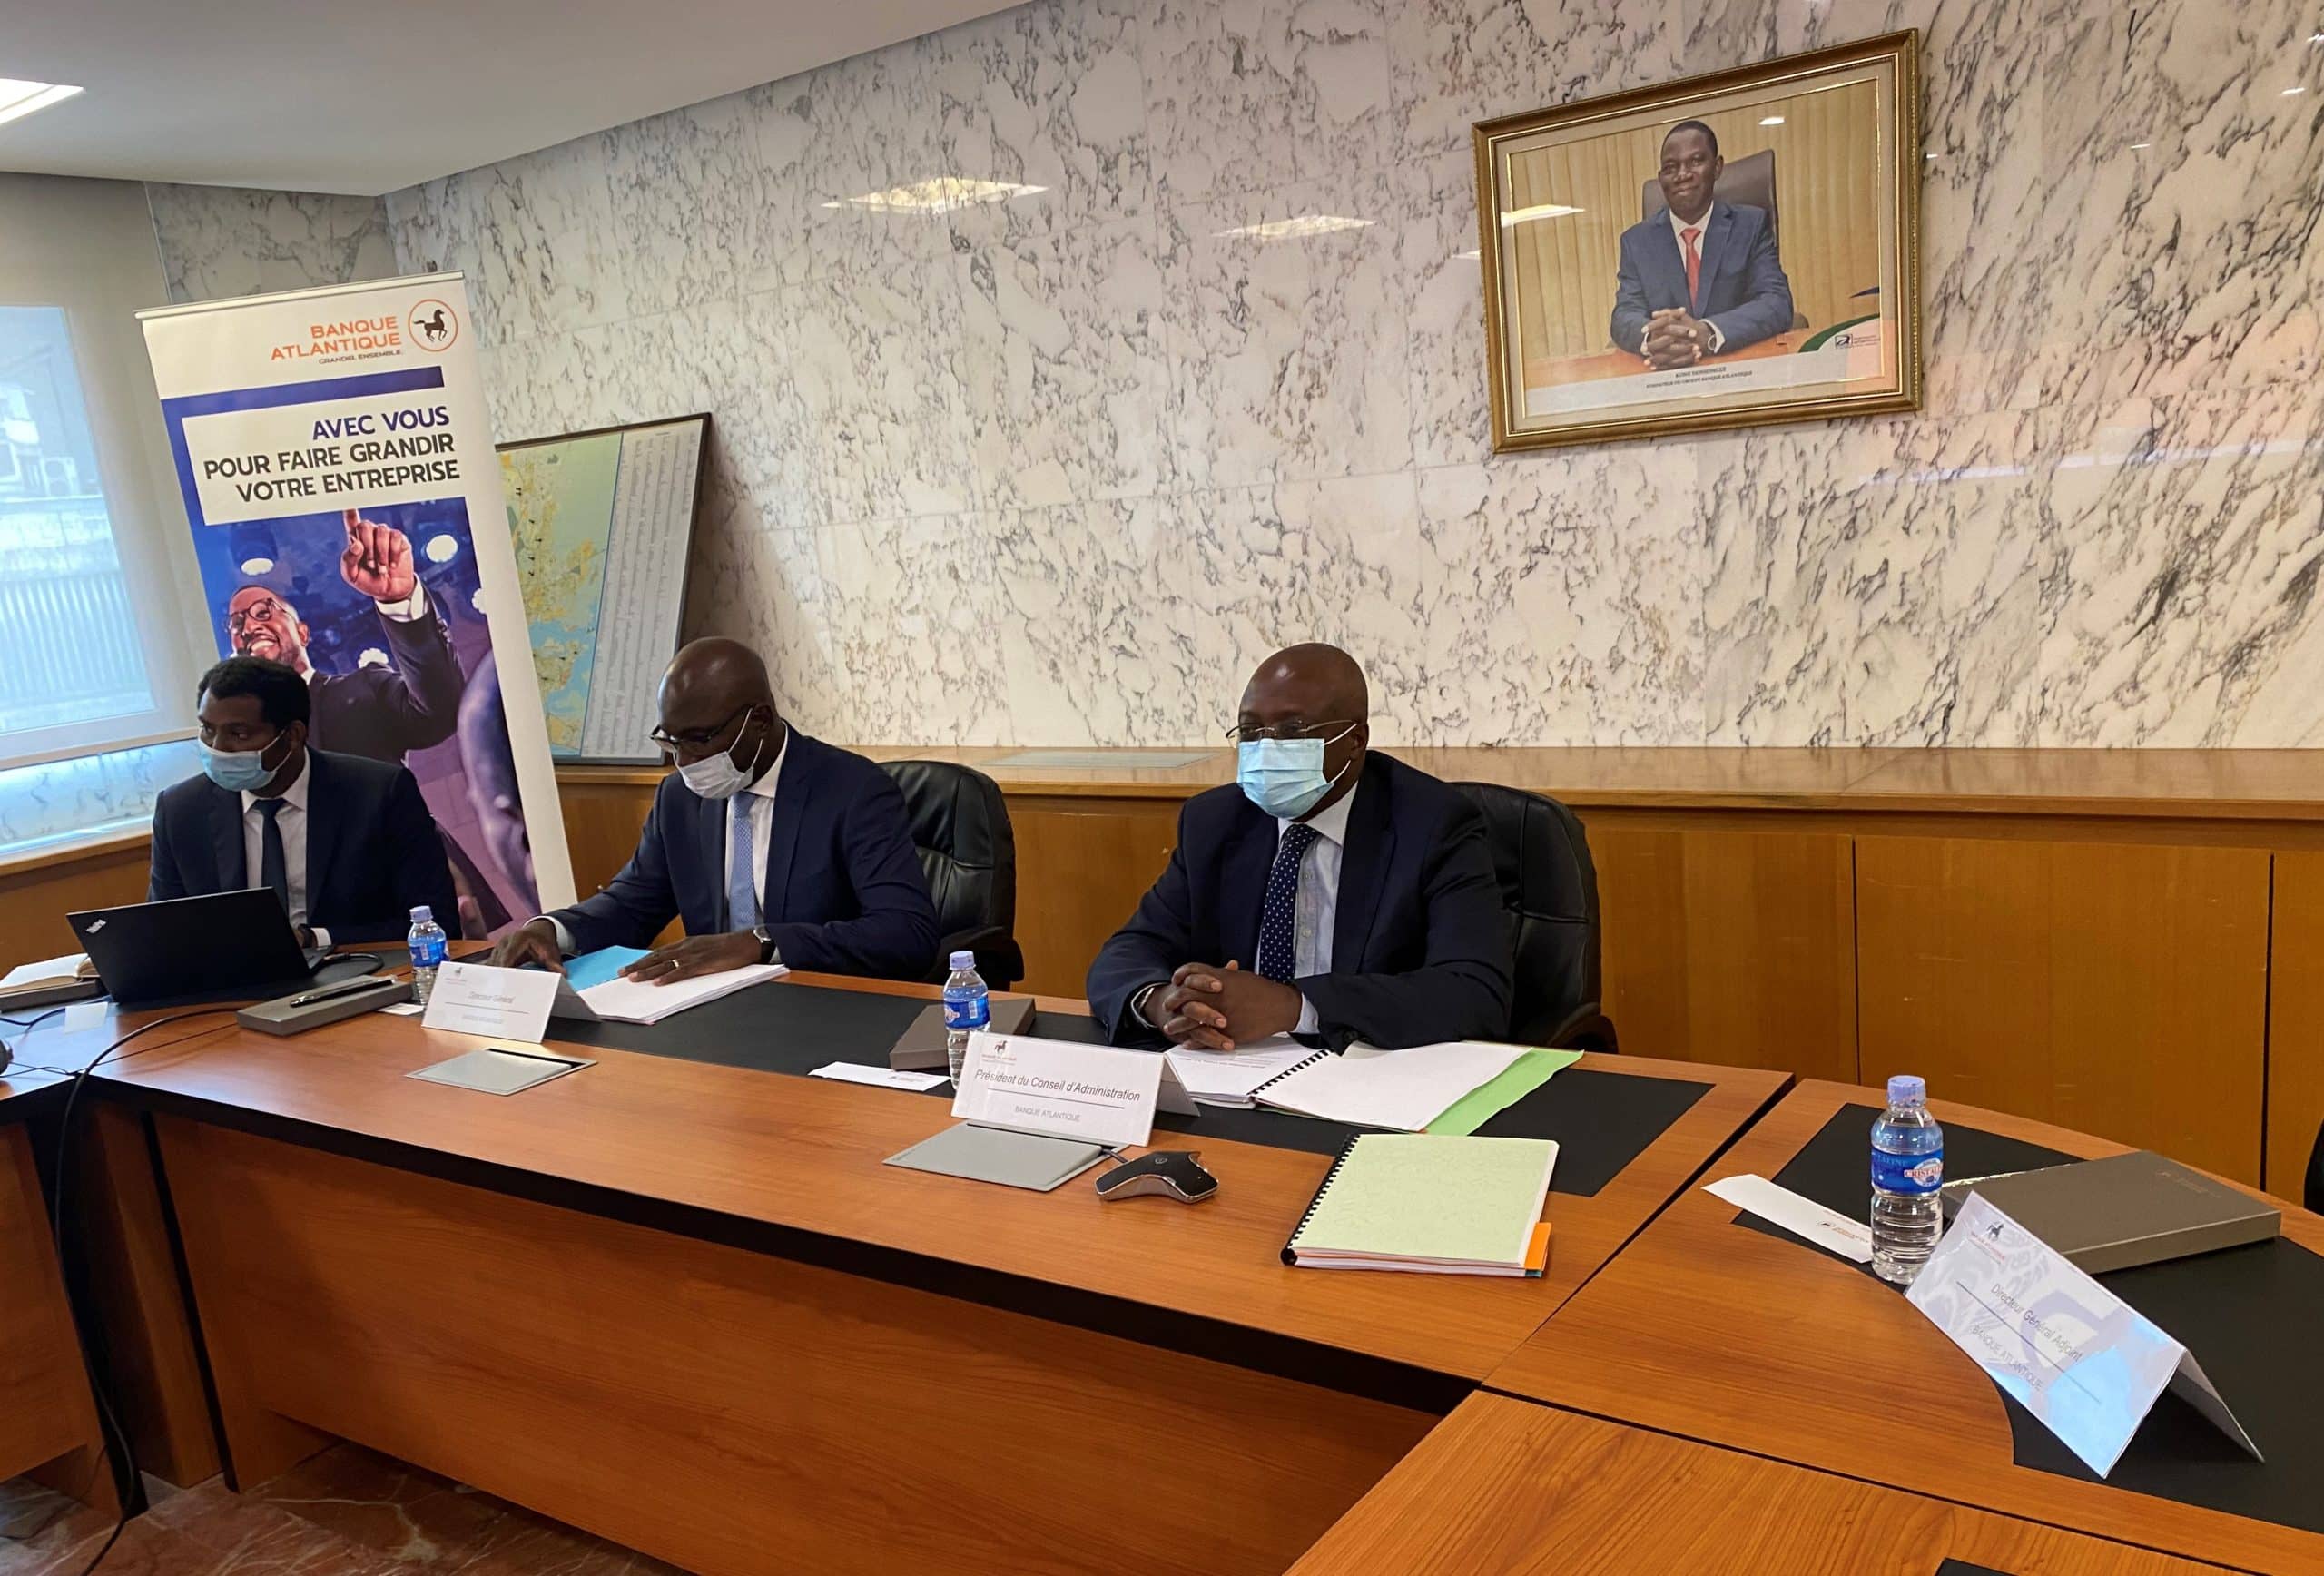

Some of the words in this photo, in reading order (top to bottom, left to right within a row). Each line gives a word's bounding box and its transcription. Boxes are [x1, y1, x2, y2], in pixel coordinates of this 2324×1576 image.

[310, 316, 399, 339] BANQUE
[271, 333, 402, 360] ATLANTIQUE
[312, 415, 375, 440] AVEC
[383, 406, 449, 431] VOUS
[203, 454, 271, 480] POUR
[278, 447, 342, 472] FAIRE
[350, 433, 455, 463] GRANDIR
[235, 475, 317, 502] VOTRE
[324, 459, 460, 493] ENTREPRISE
[974, 1069, 1016, 1085] Président
[1017, 1076, 1029, 1086] du
[1030, 1077, 1065, 1091] Conseil
[1066, 1079, 1141, 1101] d'Administration
[1014, 1105, 1041, 1118] BANQUE
[1041, 1109, 1081, 1122] ATLANTIQUE
[1991, 1284, 2024, 1314] Directeur
[2024, 1309, 2055, 1339] Général
[2053, 1335, 2083, 1362] Adjoint
[1972, 1325, 2002, 1351] BANQUE
[2001, 1350, 2043, 1391] ATLANTIQUE
